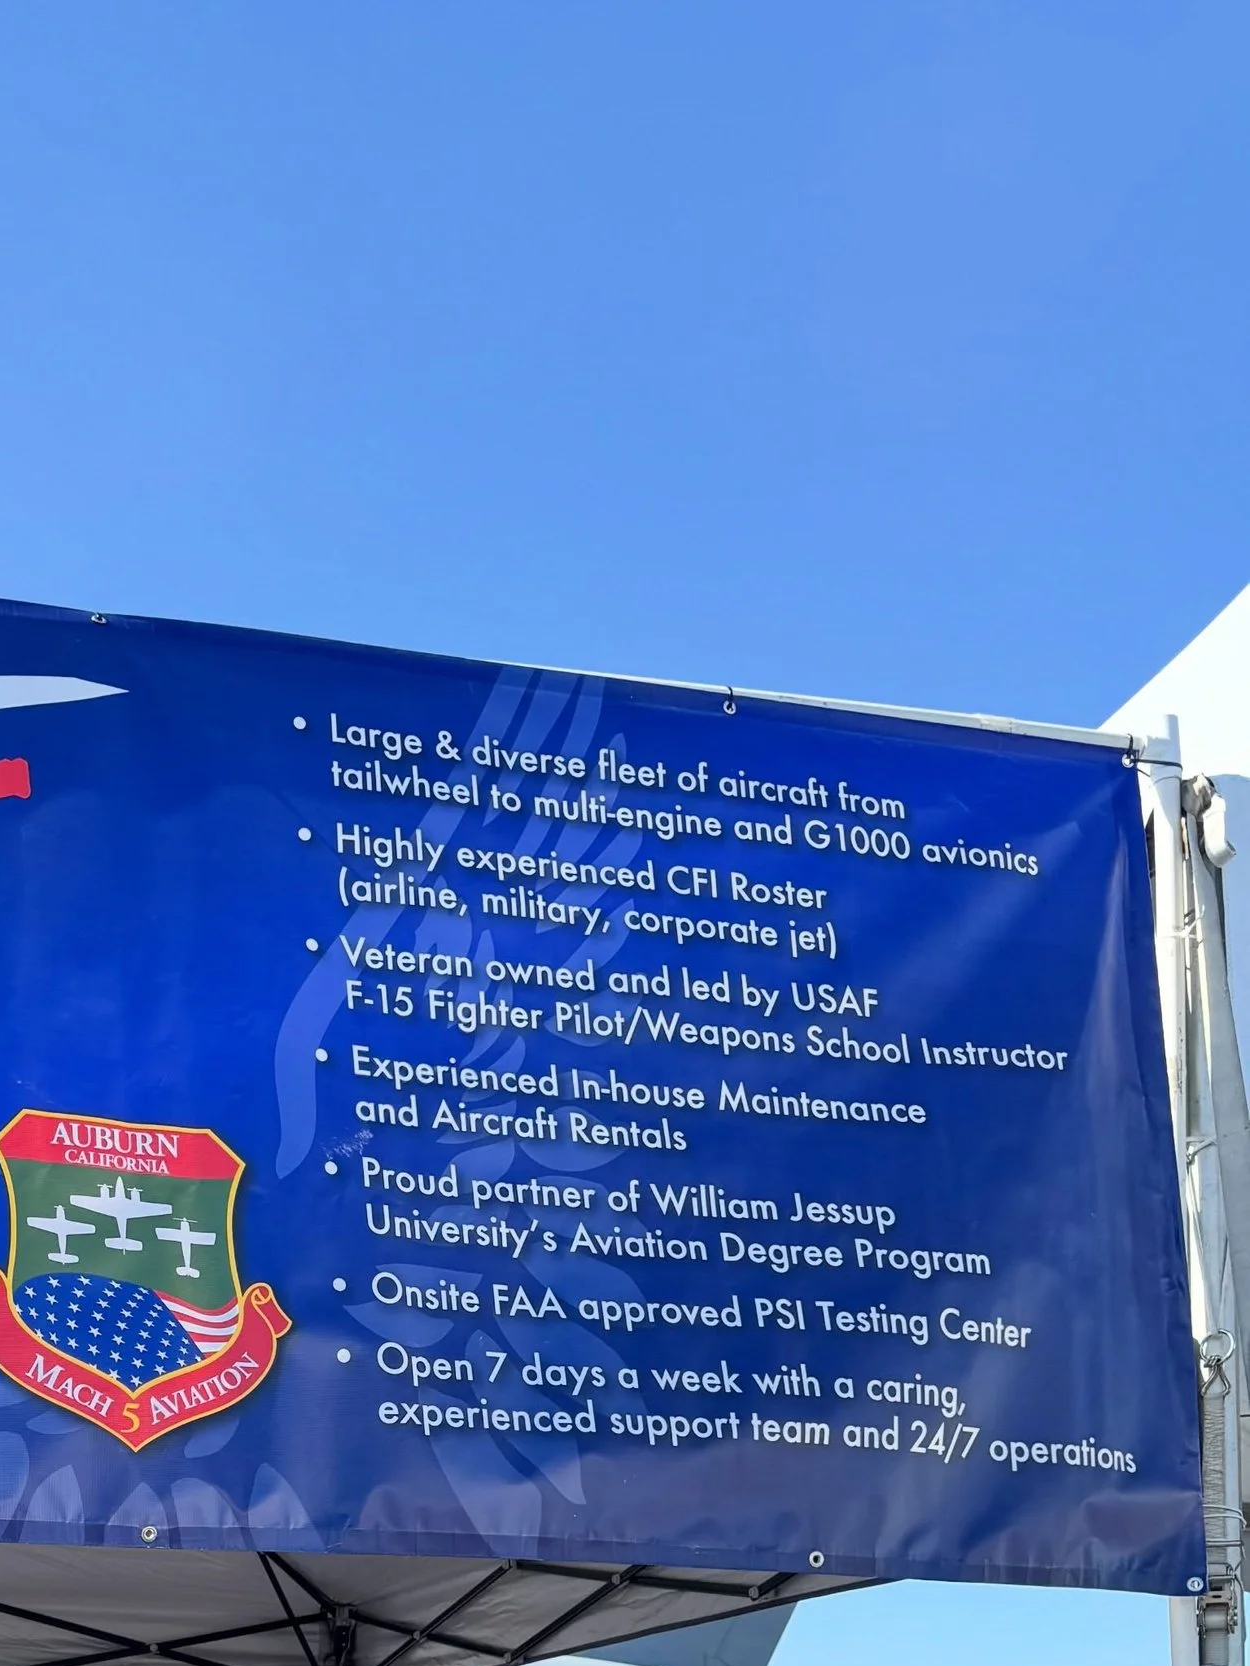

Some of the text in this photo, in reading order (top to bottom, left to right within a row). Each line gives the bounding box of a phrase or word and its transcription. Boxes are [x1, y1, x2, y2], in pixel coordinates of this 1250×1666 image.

[330, 713, 905, 819] Large & diverse fleet of aircraft from
[331, 760, 1039, 876] tailwheel to multi-engine and G1000 avionics
[336, 822, 827, 909] Highly experienced CFI Roster
[339, 866, 837, 959] (airline, military, corporate jet)
[339, 934, 878, 1018] Veteran owned and led by USAF
[346, 979, 1068, 1070] F-15 Fighter Pilot/Weapons School Instructor
[352, 1044, 927, 1124] Experienced In-house Maintenance
[355, 1094, 687, 1151] and Aircraft Rentals
[50, 1122, 180, 1159] AUBURN
[64, 1149, 169, 1175] CALIFORNIA
[362, 1156, 896, 1234] Proud partner of William Jessup
[569, 1222, 708, 1261] Aviation
[719, 1232, 843, 1273] Degree
[854, 1238, 991, 1279] Program
[371, 1271, 1032, 1348] Onsite FAA approved PSI Testing Center
[120, 1402, 141, 1433] 5
[377, 1341, 966, 1419] Open 7 days a week with a caring,
[378, 1398, 1137, 1473] experienced support team and 24/7 operations
